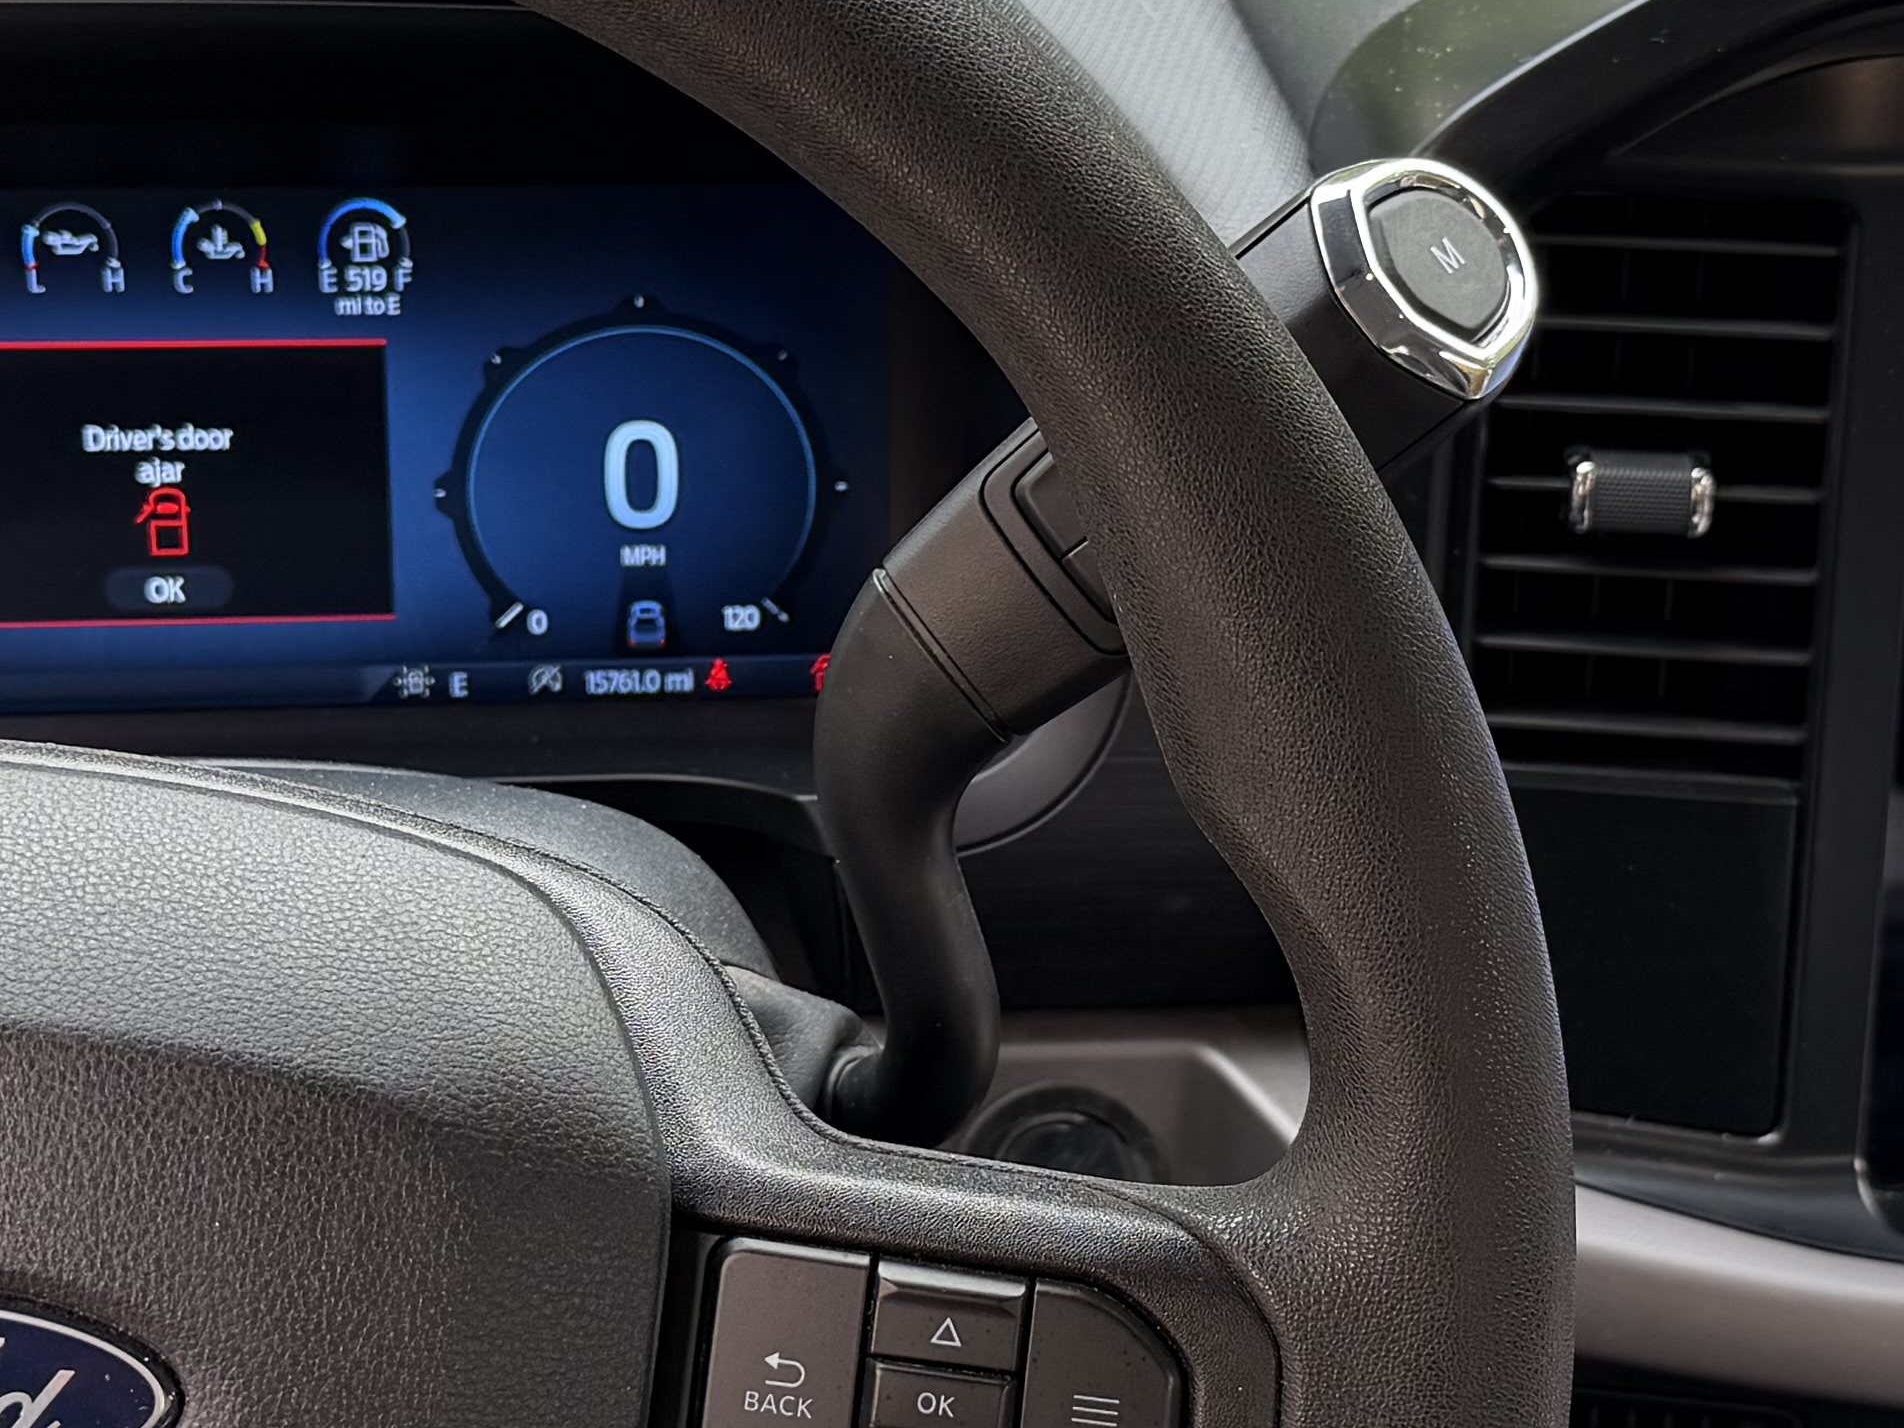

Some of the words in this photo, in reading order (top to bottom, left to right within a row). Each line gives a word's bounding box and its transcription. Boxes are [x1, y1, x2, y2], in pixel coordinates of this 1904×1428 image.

[1429, 236, 1466, 274] M
[27, 270, 46, 294] L
[102, 268, 126, 294] H
[173, 269, 194, 294] C
[250, 269, 275, 294] H
[318, 266, 338, 293] E
[344, 264, 388, 293] 519
[394, 266, 413, 292] F
[335, 293, 362, 316] mi
[363, 294, 385, 315] to
[385, 292, 401, 315] E
[82, 423, 175, 452] Driver's
[175, 422, 234, 451] door
[134, 456, 185, 488] ajar
[602, 419, 681, 529] 0
[620, 544, 667, 568] MPH
[144, 575, 187, 605] OK
[527, 609, 548, 635] 0
[722, 604, 761, 632] 120
[449, 672, 469, 698] E
[585, 668, 661, 695] 15761.0
[664, 668, 695, 693] mi
[744, 1390, 814, 1420] BACK
[916, 1392, 956, 1418] OK
